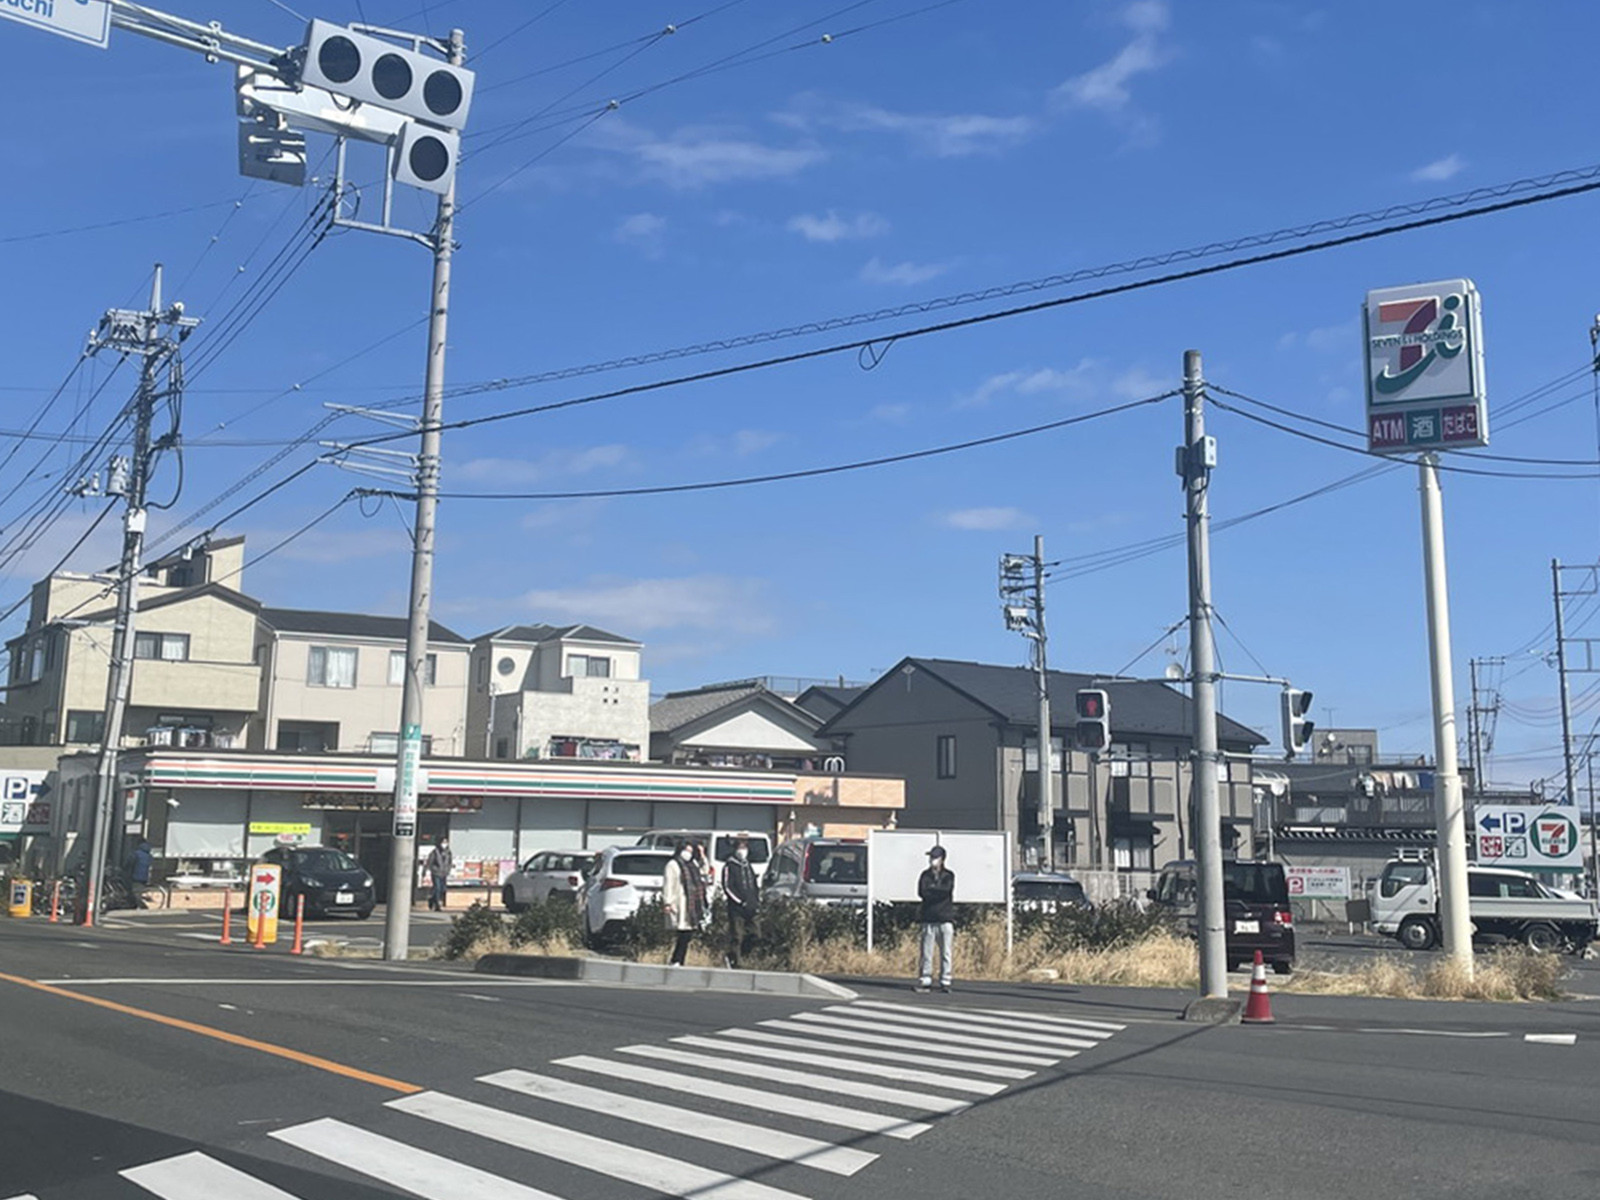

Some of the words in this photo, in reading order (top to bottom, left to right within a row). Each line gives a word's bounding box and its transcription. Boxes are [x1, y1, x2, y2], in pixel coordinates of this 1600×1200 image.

[1372, 418, 1404, 442] ATM
[1412, 415, 1435, 439] 酒
[1443, 413, 1477, 436] たばこ
[7, 777, 27, 799] P
[1506, 813, 1524, 833] P
